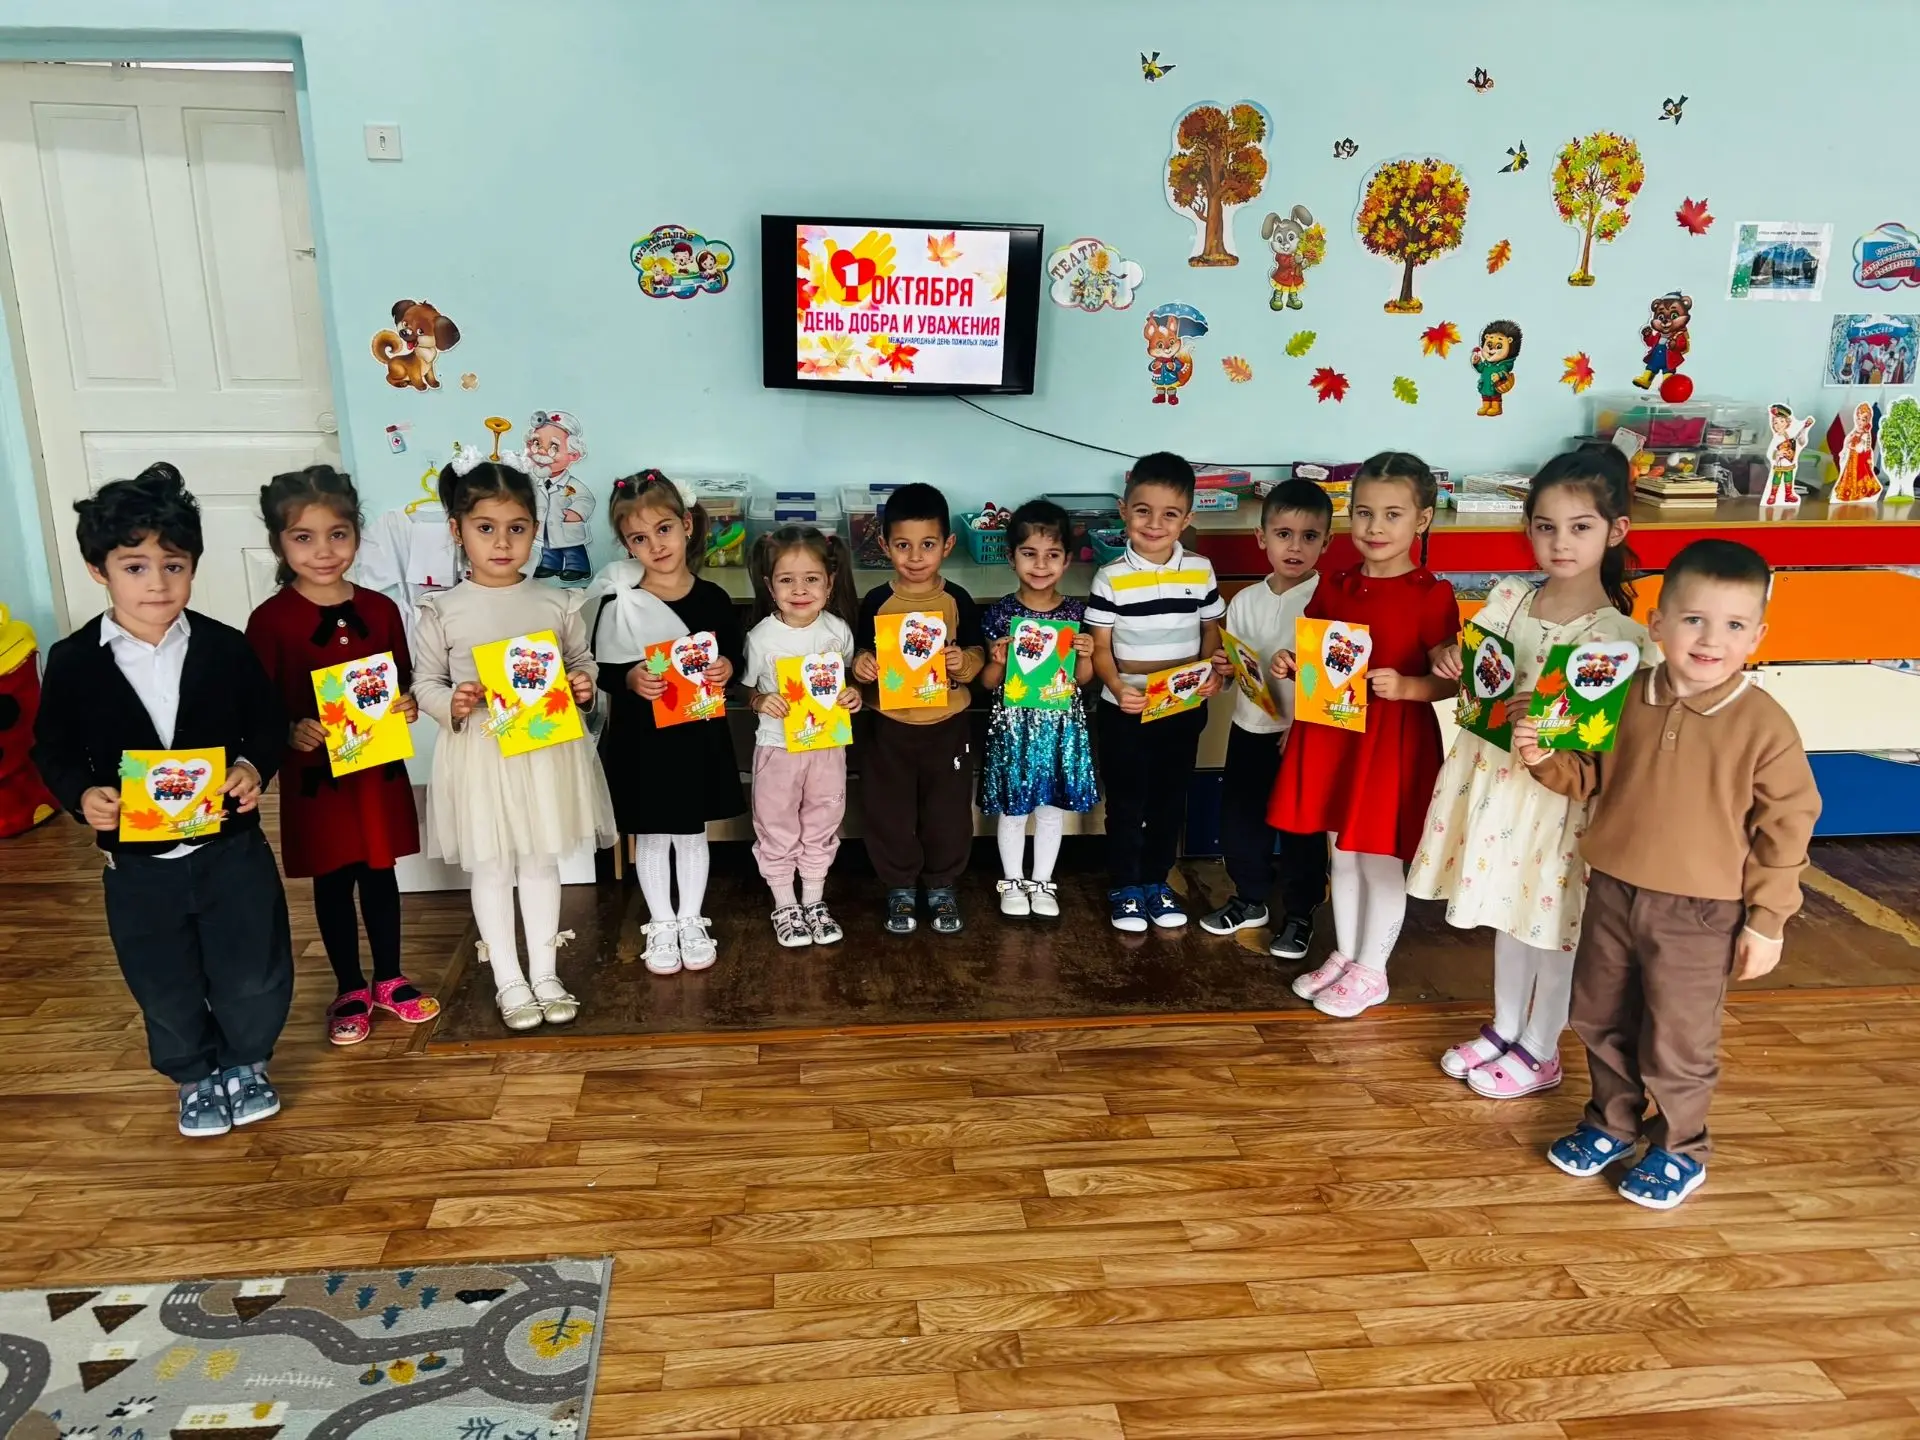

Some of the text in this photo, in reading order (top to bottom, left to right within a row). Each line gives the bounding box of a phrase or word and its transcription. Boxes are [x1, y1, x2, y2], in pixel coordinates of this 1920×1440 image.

[1050, 242, 1098, 280] ТЕАТР
[841, 262, 974, 308] 1 ОКТЯБРЯ
[803, 311, 1000, 336] ДЕНЬ ДОБРА И УВАЖЕНИЯ
[888, 336, 999, 347] МЕЖДУНАРОДНЫЙ ДЕНЬ ПОЖИЛЫХ ЛЮДЕЙ
[1329, 703, 1360, 714] ОКТЯБРЯ
[1536, 719, 1571, 729] КТЯБРЯ
[179, 813, 219, 829] ОКТЯБРЯ
